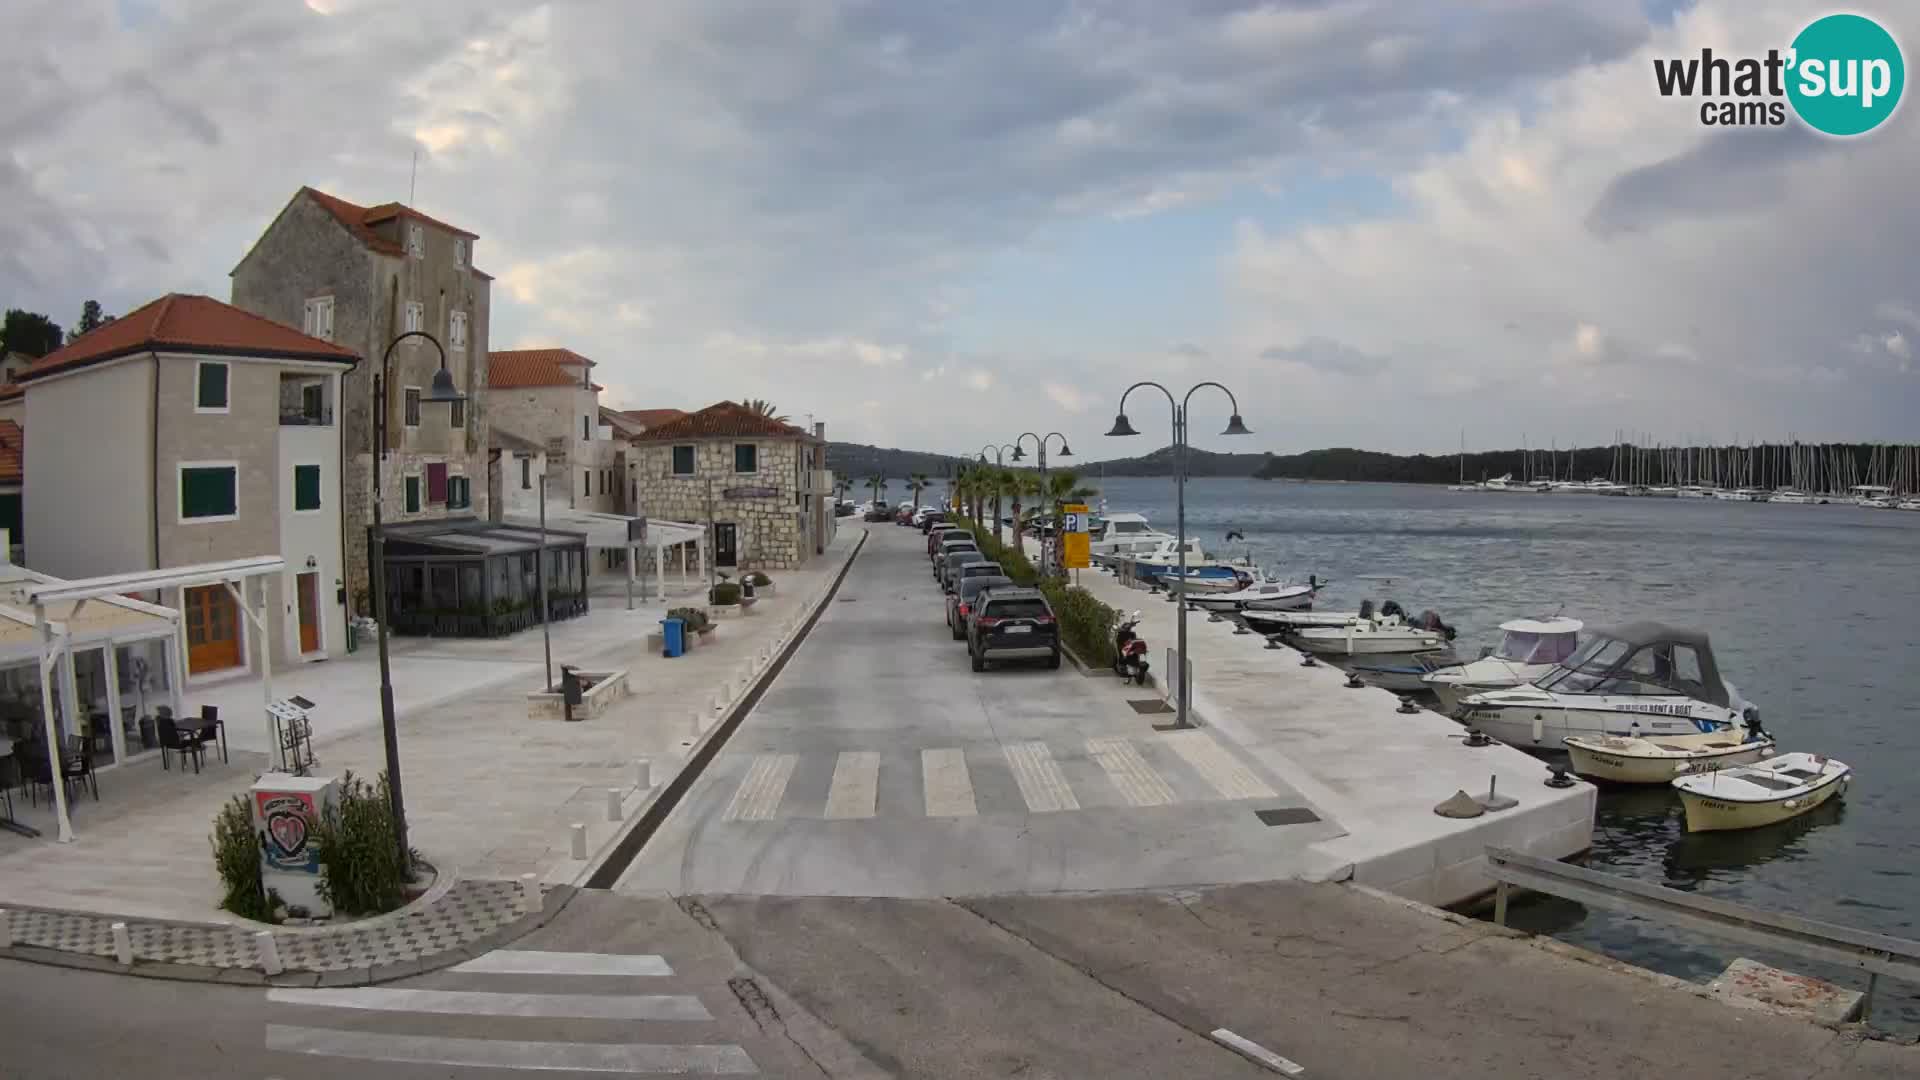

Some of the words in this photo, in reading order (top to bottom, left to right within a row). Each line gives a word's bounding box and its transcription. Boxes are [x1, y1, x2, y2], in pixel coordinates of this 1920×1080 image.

[1066, 514, 1076, 531] P
[1648, 703, 1668, 713] RENT
[1675, 704, 1693, 717] BOAT
